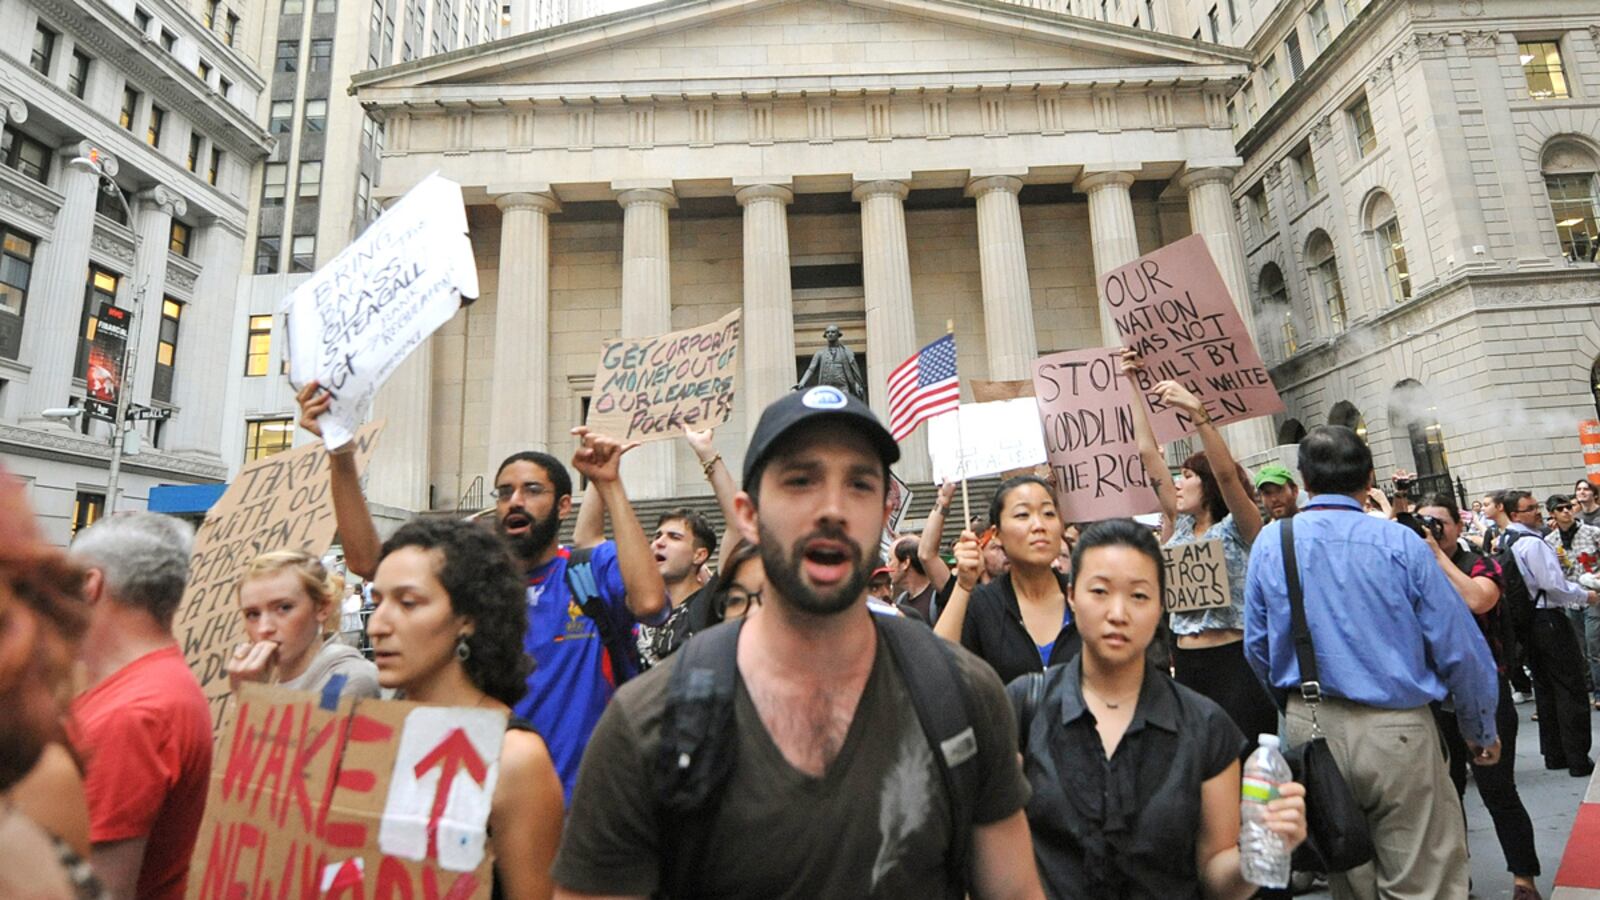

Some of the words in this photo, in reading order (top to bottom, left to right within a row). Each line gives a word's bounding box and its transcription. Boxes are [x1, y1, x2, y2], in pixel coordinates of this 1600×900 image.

[313, 230, 391, 308] BRING
[1105, 260, 1173, 307] OUR
[322, 256, 401, 345] GLASS
[323, 261, 426, 368] STEAGALL
[1114, 291, 1199, 337] NATION
[603, 340, 658, 369] GET
[650, 320, 739, 366] CORPORATE
[1129, 333, 1168, 358] WAS
[1167, 313, 1224, 342] NOT
[602, 363, 676, 392] MONEY
[676, 352, 719, 380] OUT
[718, 345, 736, 370] OF
[1135, 352, 1200, 391] BUILT
[1203, 342, 1239, 366] BY
[596, 392, 650, 413] OUR
[653, 376, 733, 405] LEADERS
[1145, 379, 1204, 414] RH
[1206, 367, 1268, 392] WHITE
[1045, 404, 1136, 453] CODDLIN
[289, 480, 329, 512] OU
[1053, 461, 1089, 493] THE
[1164, 548, 1174, 562] I
[1182, 542, 1211, 561] AM
[1164, 561, 1219, 586] TROY
[1166, 583, 1225, 609] DAVIS
[222, 701, 394, 848] WAKE
